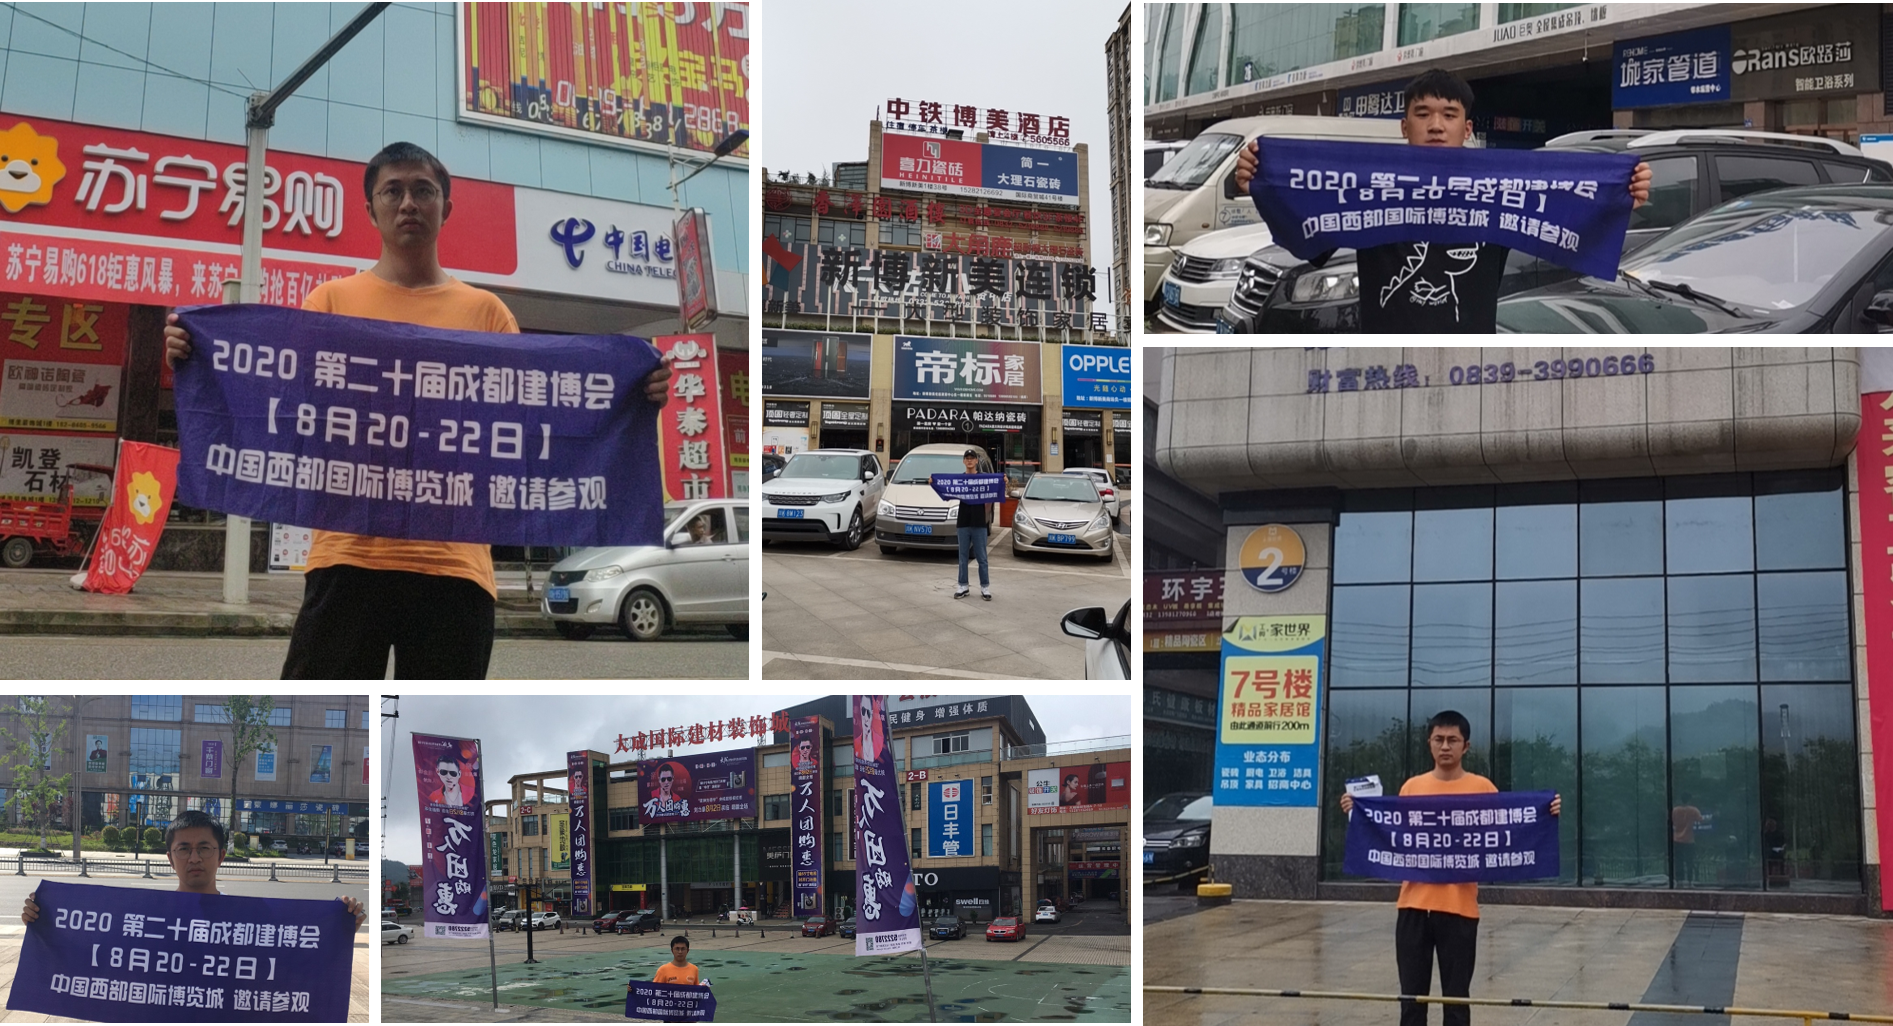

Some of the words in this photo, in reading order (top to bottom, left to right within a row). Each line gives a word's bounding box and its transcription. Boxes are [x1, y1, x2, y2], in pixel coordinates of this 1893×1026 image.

[1493, 26, 1516, 42] JUAO
[1800, 41, 1851, 65] 欧路莎
[1795, 73, 1854, 92] 智能卫浴系列
[886, 97, 1070, 138] 中铁博美酒店
[899, 156, 963, 177] 喜力瓷砖
[1020, 156, 1049, 169] 简一
[899, 172, 964, 184] HEINITILE
[997, 173, 1061, 190] 大理石瓷砖
[1289, 168, 1357, 190] 2020
[74, 142, 343, 238] 苏宁易购
[1302, 207, 1490, 239] 中国西部国际博览城
[1499, 212, 1580, 253] 邀请参观
[606, 259, 643, 275] CHINA
[820, 247, 1097, 302] 新博新美连锁
[2, 296, 104, 350] 专区
[8, 364, 86, 384] 欧神诺陶瓷
[211, 338, 299, 381] 2020
[314, 350, 616, 411] 第二十届成都建博会
[915, 350, 1001, 385] 帝标
[1003, 354, 1025, 387] 家居
[1069, 354, 1131, 374] OPPLE
[1449, 354, 1656, 386] 0839-3990666
[907, 408, 970, 420] PADARA
[973, 411, 1027, 422] 帕达纳瓷砖
[266, 397, 553, 462] 【8月20-22日】
[673, 372, 713, 499] 华泰超市
[12, 446, 62, 470] 凯登
[24, 470, 71, 493] 石材
[205, 442, 474, 508] 中国西部国际博览城
[488, 474, 608, 511] 邀请参观
[1256, 547, 1284, 586] 2
[1270, 623, 1311, 637] 家世界
[1231, 669, 1312, 699] 7号楼
[934, 700, 989, 719] 增强体质
[1231, 702, 1311, 717] 精品家居馆
[613, 710, 790, 754] 大成国际建材装饰城
[1230, 721, 1310, 731] 由此通道前行200m
[1243, 751, 1291, 763] 业态分布
[907, 771, 926, 780] 2-B
[1221, 767, 1239, 778] 瓷砖
[1268, 768, 1287, 778] 卫浴
[1221, 779, 1238, 790] 吊顶
[1245, 780, 1263, 790] 家具
[1268, 779, 1312, 790] 招商中心
[1365, 809, 1402, 825] 2020
[1408, 806, 1537, 826] 第二十届成都建博会
[942, 803, 960, 856] 日丰管
[1368, 849, 1480, 869] 中国西部国际博览城
[1485, 850, 1536, 868] 邀请参观
[55, 908, 112, 932] 2020
[123, 913, 321, 949] 第二十届成都建博会
[91, 944, 276, 981] 【8月20-22日】
[50, 974, 224, 1009] 中国西部国际博览城
[233, 989, 310, 1013] 邀请参观
